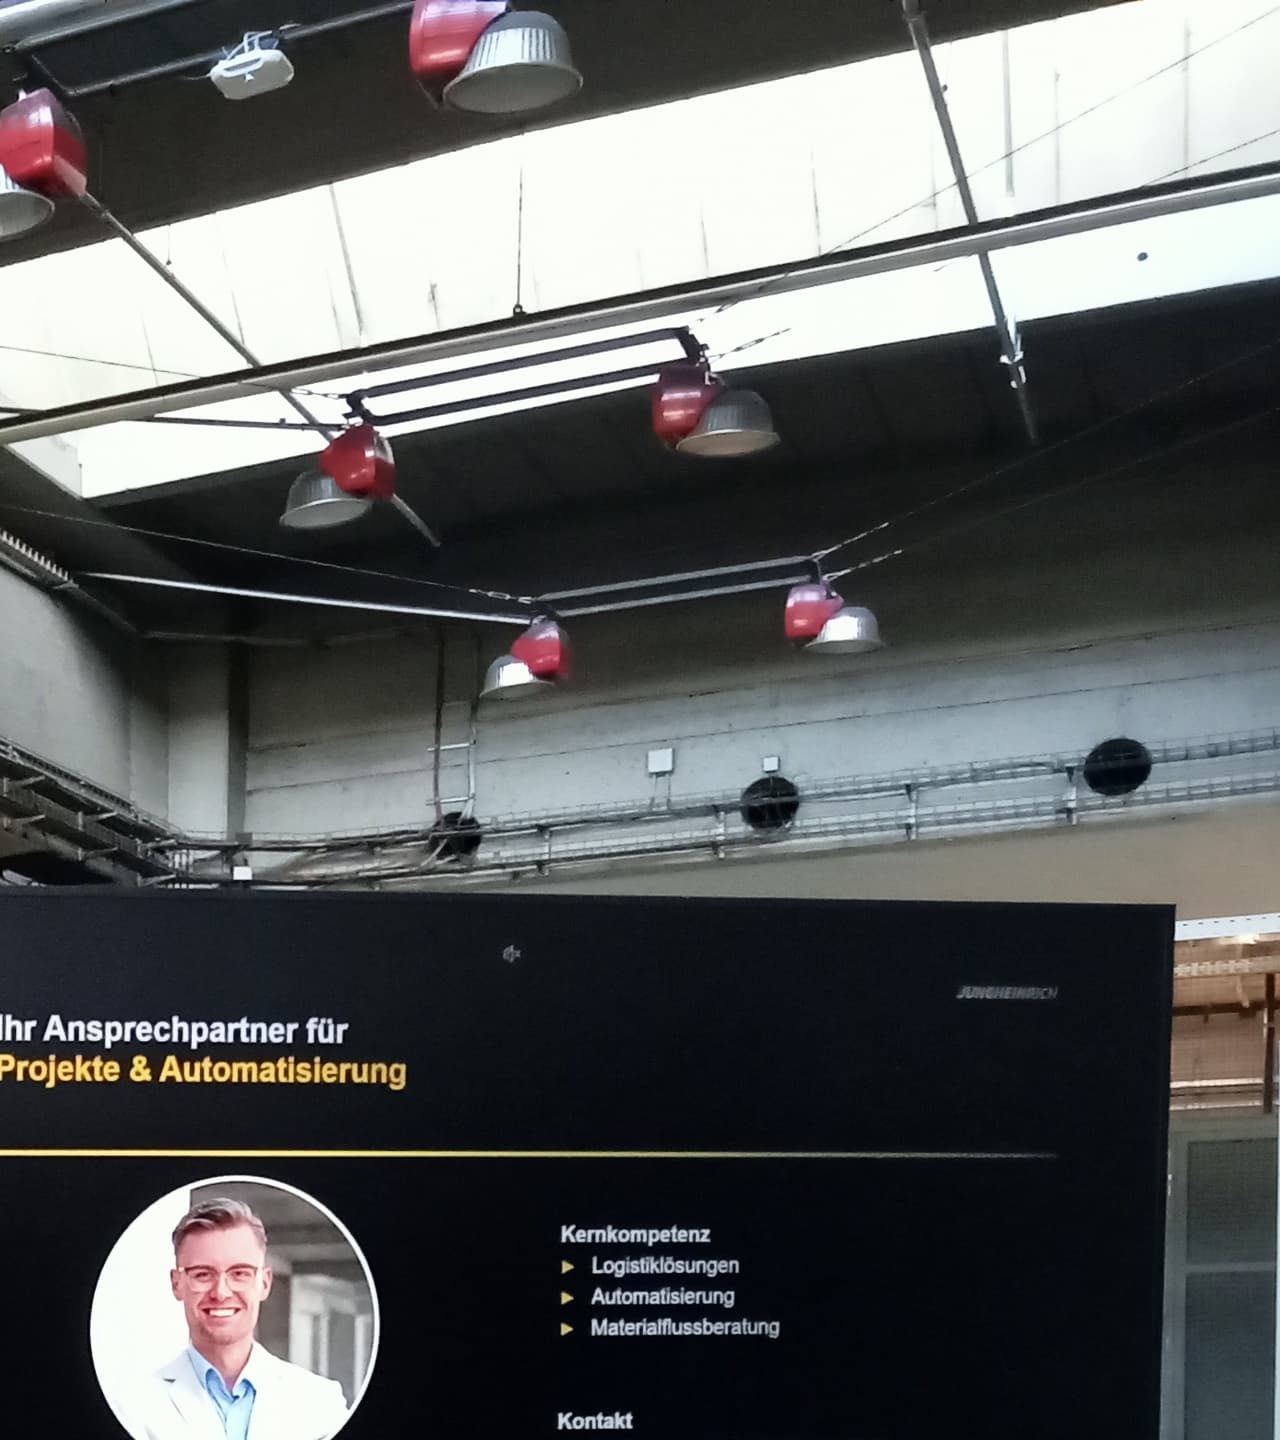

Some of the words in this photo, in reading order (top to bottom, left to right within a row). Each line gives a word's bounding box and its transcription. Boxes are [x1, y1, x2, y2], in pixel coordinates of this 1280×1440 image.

[955, 985, 1059, 1000] JUNGHEINRICH
[42, 1014, 300, 1050] Ansprechpartner
[306, 1016, 350, 1044] für
[128, 1054, 153, 1083] &
[158, 1054, 407, 1091] Automatisierung
[560, 1224, 711, 1247] Kernkompetenz
[591, 1255, 740, 1278] Logistiklösungen
[590, 1286, 736, 1308] Automatisierung
[590, 1317, 781, 1339] Materialflussberatung
[557, 1411, 634, 1431] Kontakt
